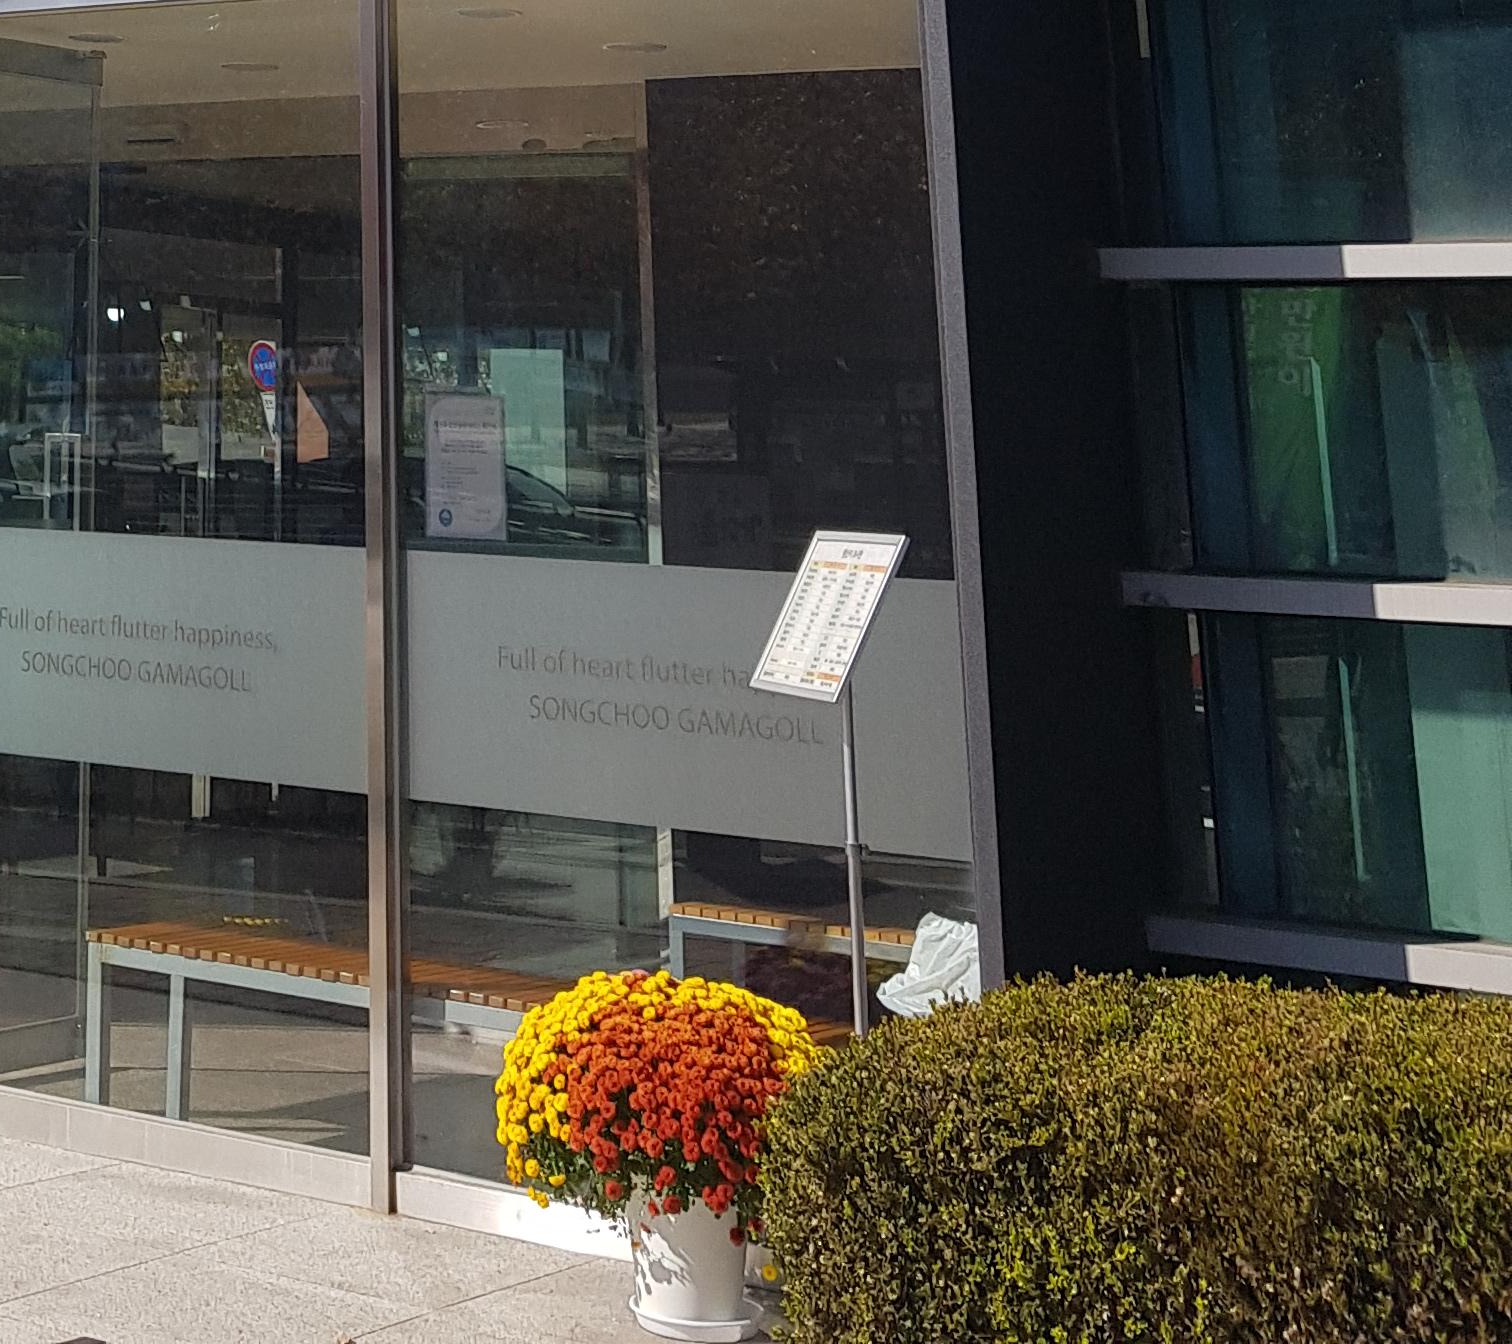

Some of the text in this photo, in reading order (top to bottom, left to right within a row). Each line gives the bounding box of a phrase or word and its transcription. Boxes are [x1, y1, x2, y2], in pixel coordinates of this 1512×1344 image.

[0, 606, 278, 653] Full of heart flutter happiness,
[22, 650, 251, 692] SONGCHOO GAMAGOLL
[498, 646, 536, 672] Full
[543, 649, 568, 674] of
[572, 652, 634, 681] heart
[641, 655, 714, 686] flutter
[529, 695, 824, 745] SONGCHOO GAMAGOLL
